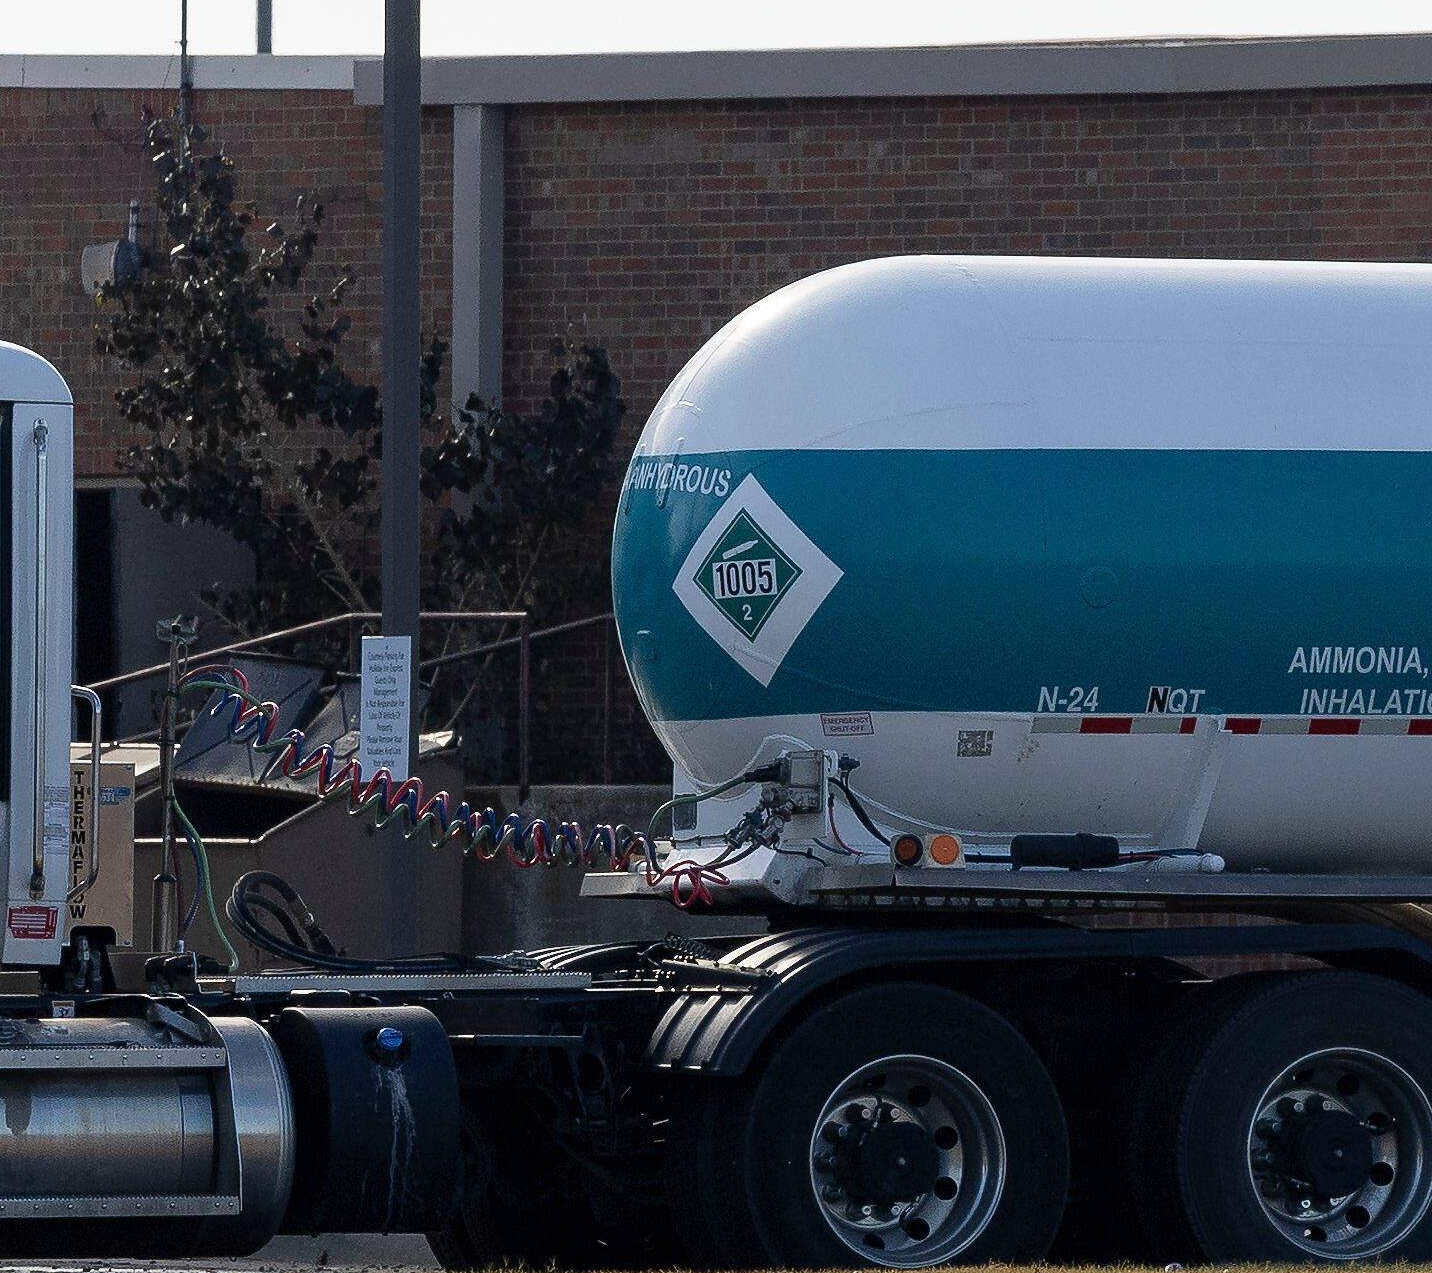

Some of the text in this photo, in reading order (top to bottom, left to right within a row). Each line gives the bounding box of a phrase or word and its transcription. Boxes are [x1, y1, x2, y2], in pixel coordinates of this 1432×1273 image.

[715, 561, 773, 597] 1005
[742, 604, 753, 621] 2
[1287, 647, 1430, 679] AMMONIA,
[1037, 686, 1099, 713] N-24
[1146, 685, 1206, 714] NQT
